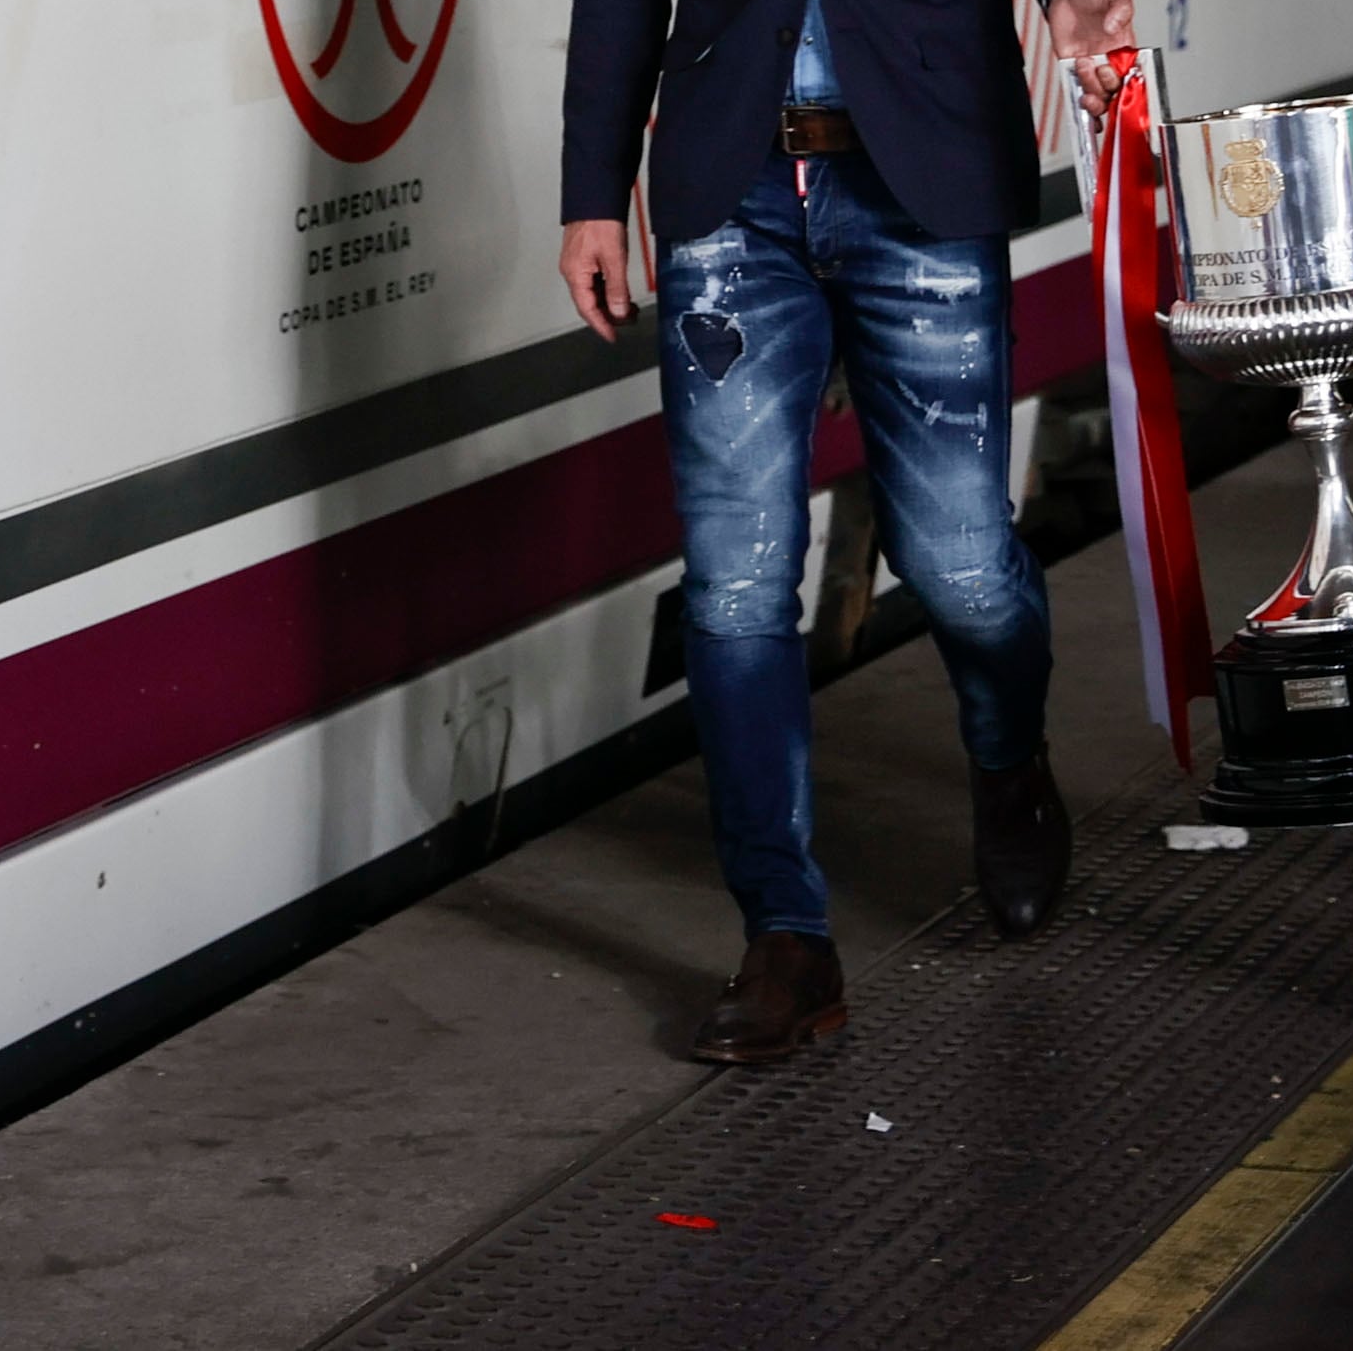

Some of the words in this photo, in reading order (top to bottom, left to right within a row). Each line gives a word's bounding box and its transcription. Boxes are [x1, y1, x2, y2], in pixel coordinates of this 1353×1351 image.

[296, 179, 423, 232] CAMPEONATO
[309, 246, 332, 276] DE
[340, 222, 411, 268] ESPAÑA
[279, 303, 320, 333] COPA
[326, 295, 346, 320] DE
[386, 281, 404, 302] EL
[408, 270, 436, 295] REY
[1222, 270, 1246, 285] DE
